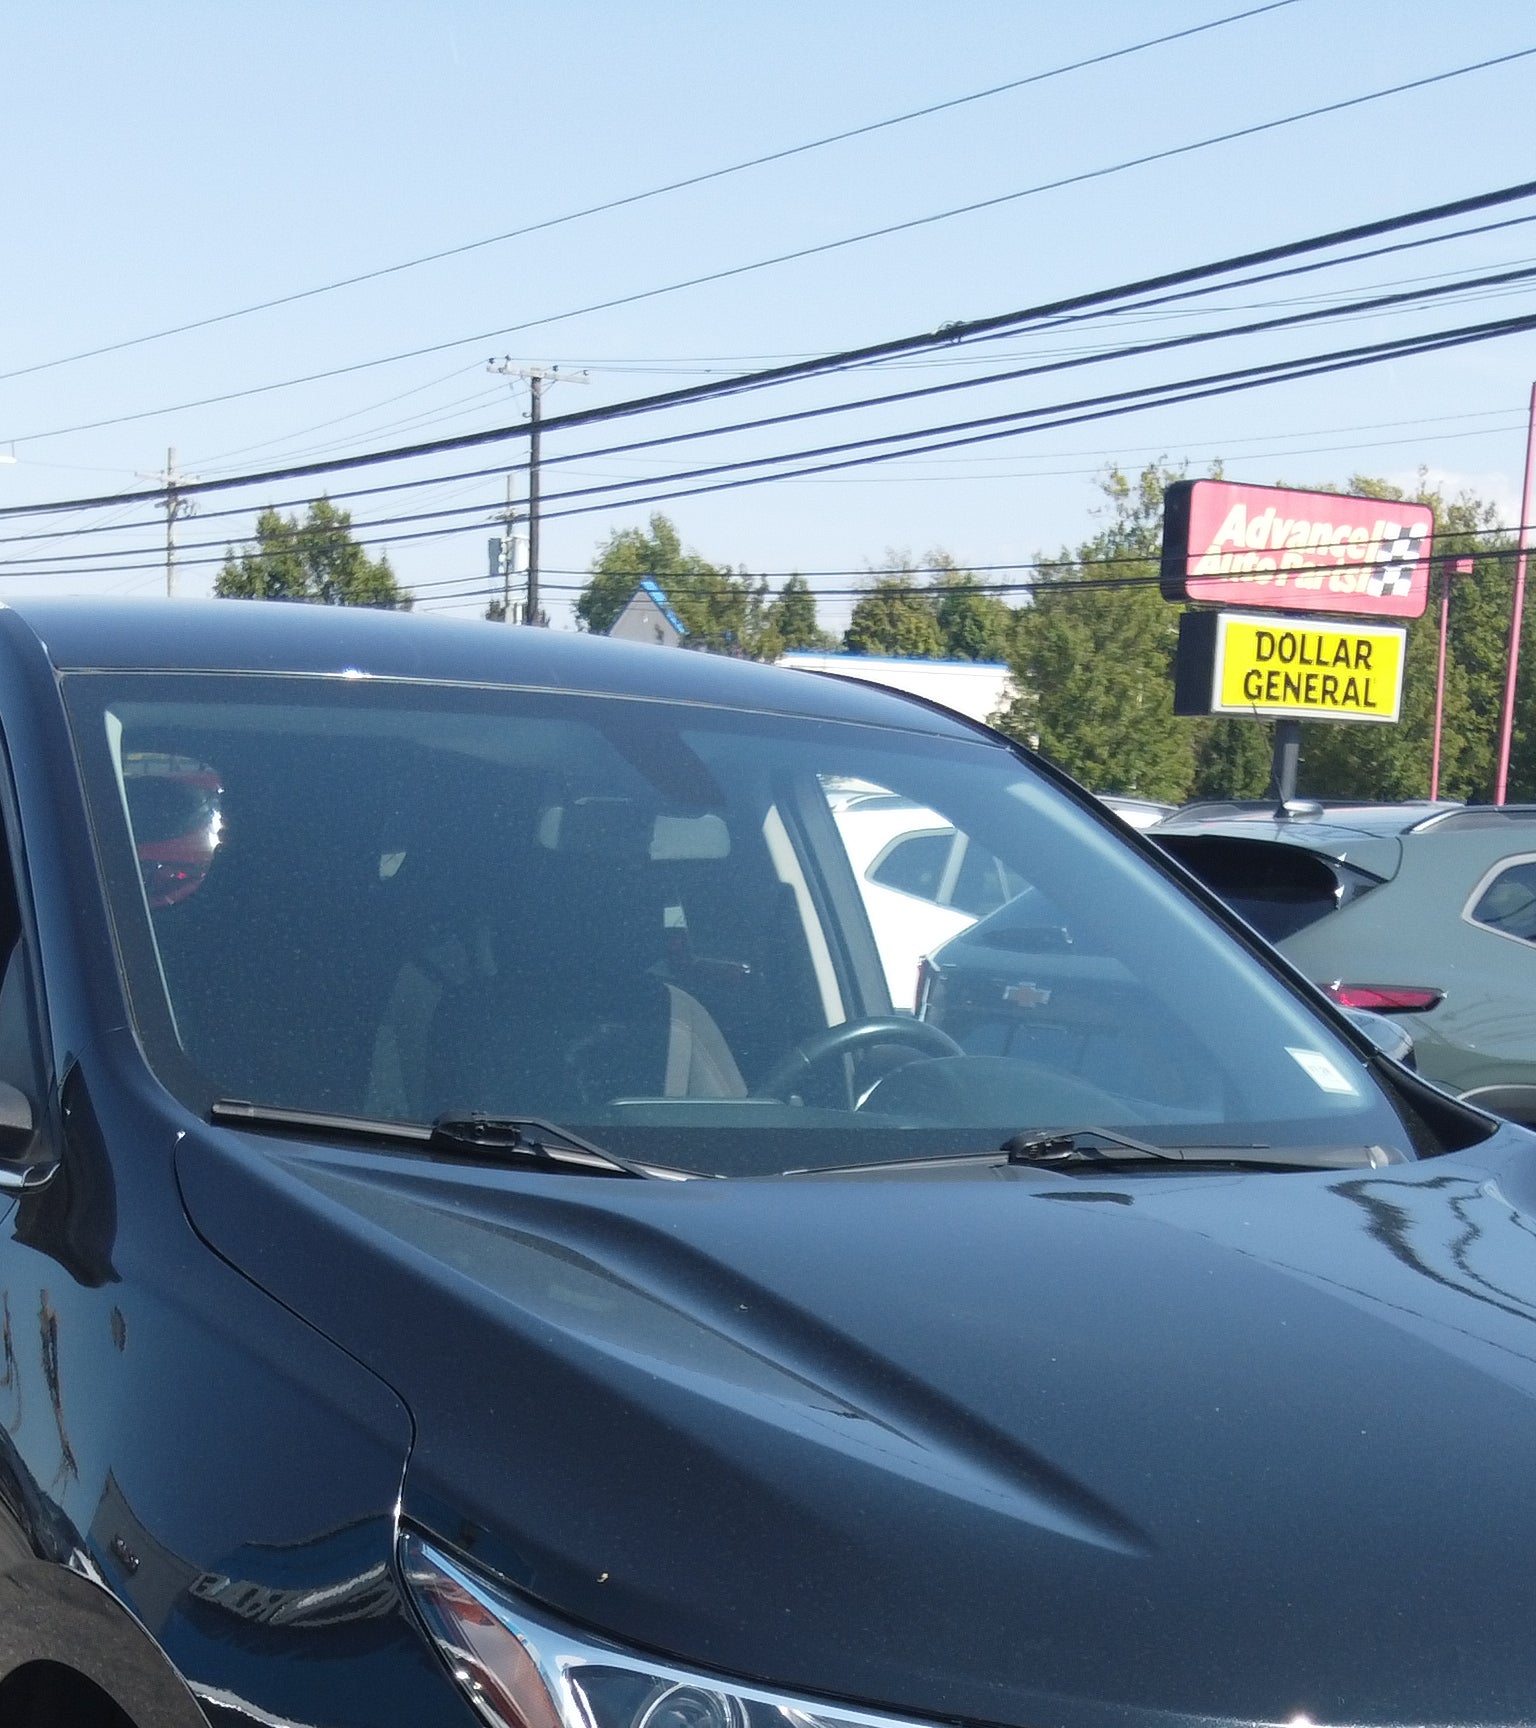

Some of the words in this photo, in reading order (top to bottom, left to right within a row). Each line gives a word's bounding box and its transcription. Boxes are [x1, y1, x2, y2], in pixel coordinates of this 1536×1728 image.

[1213, 503, 1373, 560] Advance
[1193, 543, 1276, 586] Auto
[1255, 630, 1373, 670] DOLLAR
[1243, 669, 1377, 708] GENERAL
